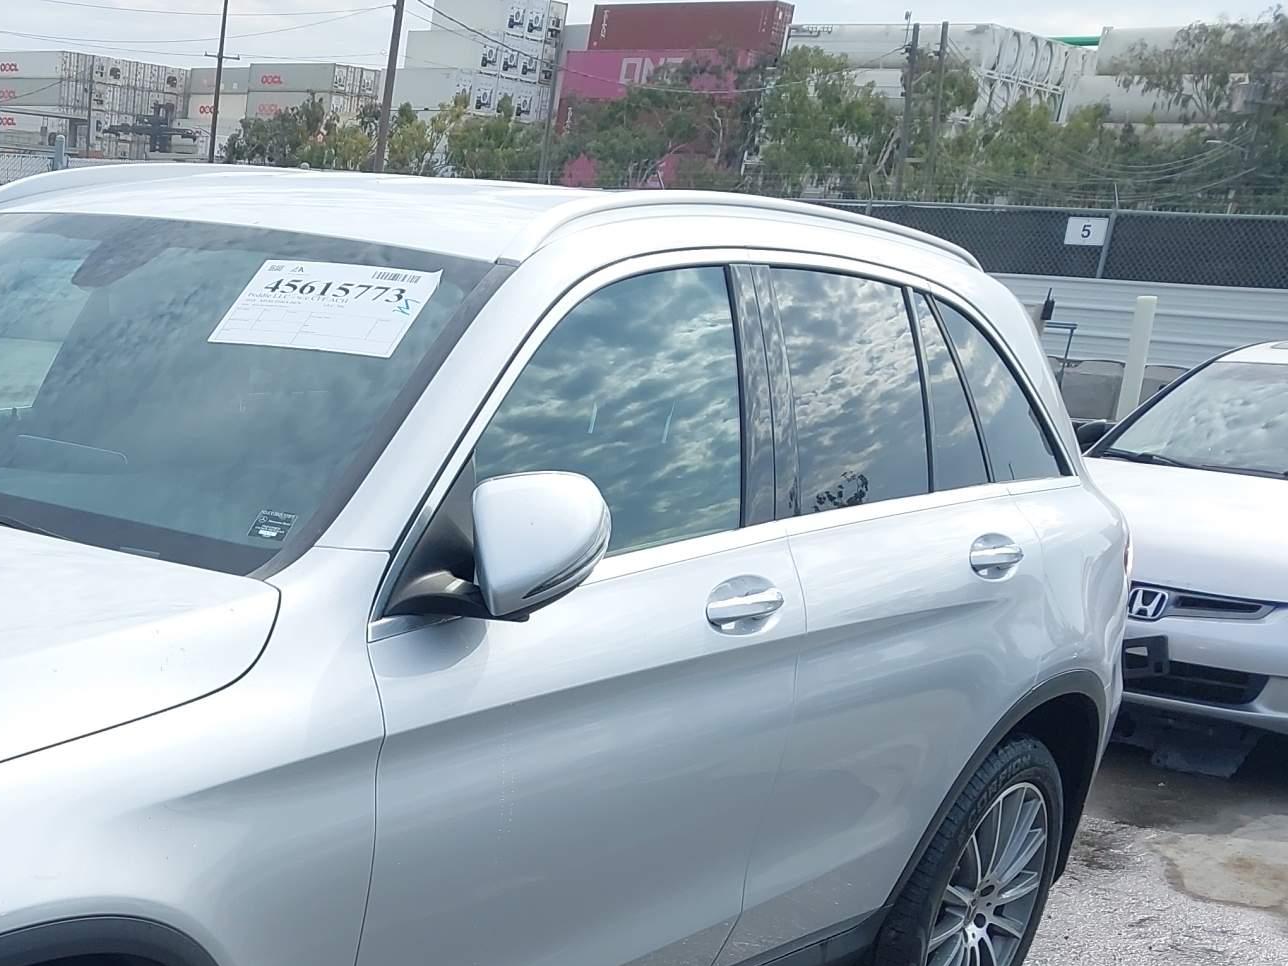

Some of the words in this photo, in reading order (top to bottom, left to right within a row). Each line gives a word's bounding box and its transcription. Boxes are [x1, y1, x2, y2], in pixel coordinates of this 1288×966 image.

[0, 62, 19, 72] OOCL
[261, 75, 282, 84] OOCL
[199, 105, 215, 114] OOC
[1081, 224, 1092, 238] 5
[264, 278, 406, 303] 45615773
